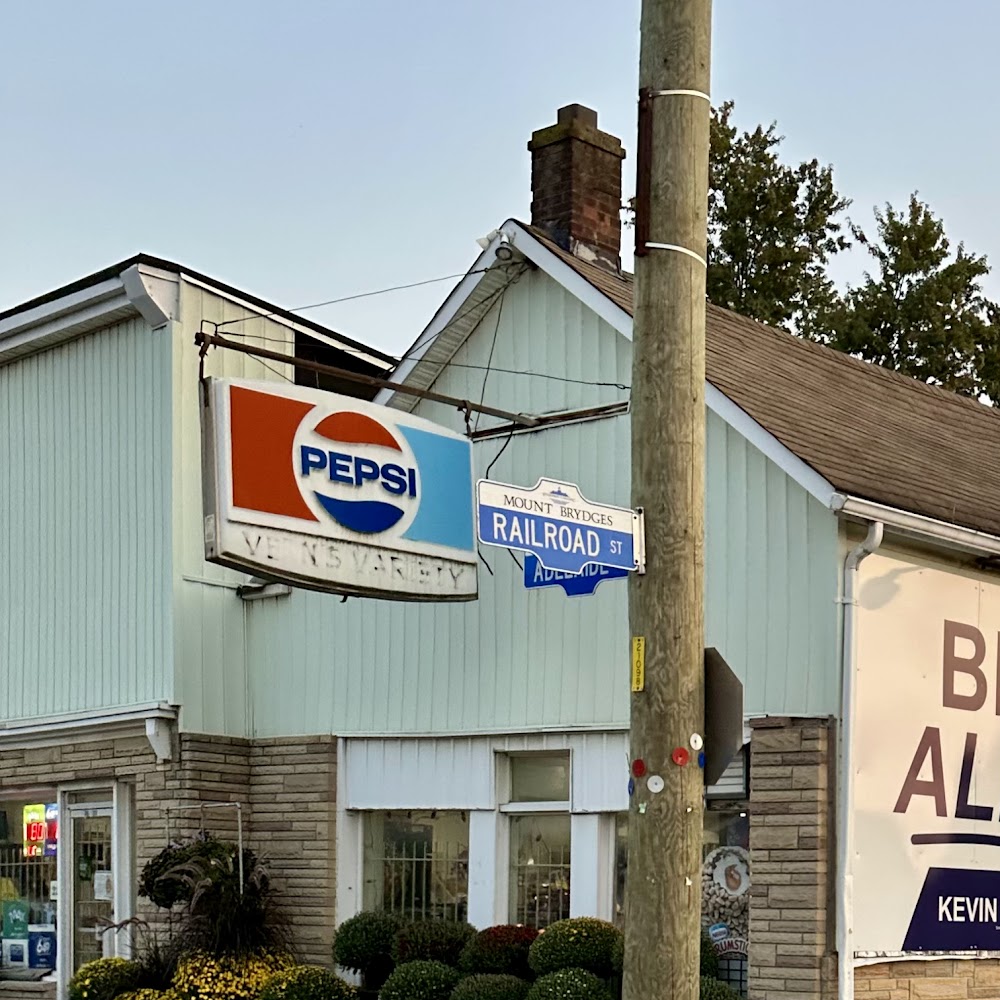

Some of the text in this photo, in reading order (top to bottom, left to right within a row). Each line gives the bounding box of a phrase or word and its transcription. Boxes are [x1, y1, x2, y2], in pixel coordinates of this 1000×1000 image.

[300, 445, 418, 498] PEPSI
[503, 494, 614, 526] MOUNT BRYDGES
[493, 512, 623, 557] RAILROAD ST
[533, 560, 610, 583] ADIDE
[938, 896, 998, 923] KEVIN
